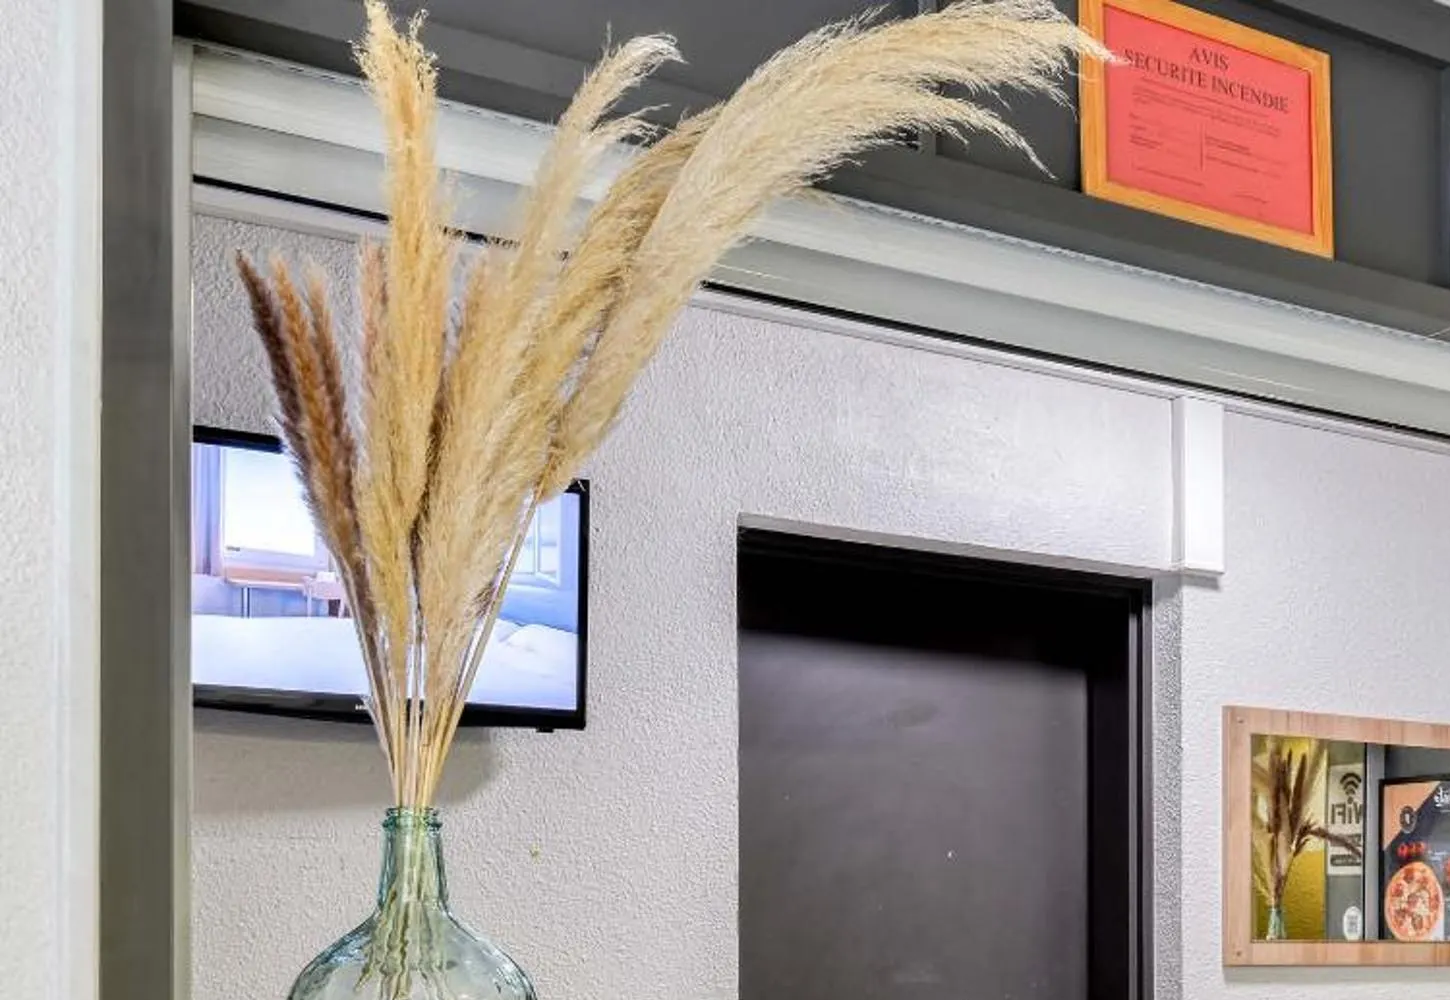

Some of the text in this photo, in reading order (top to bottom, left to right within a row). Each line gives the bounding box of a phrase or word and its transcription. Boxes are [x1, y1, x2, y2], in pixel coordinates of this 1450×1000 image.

[1124, 49, 1208, 88] SECURITE
[1211, 75, 1289, 114] INCENDIE
[1189, 48, 1230, 71] AVIS
